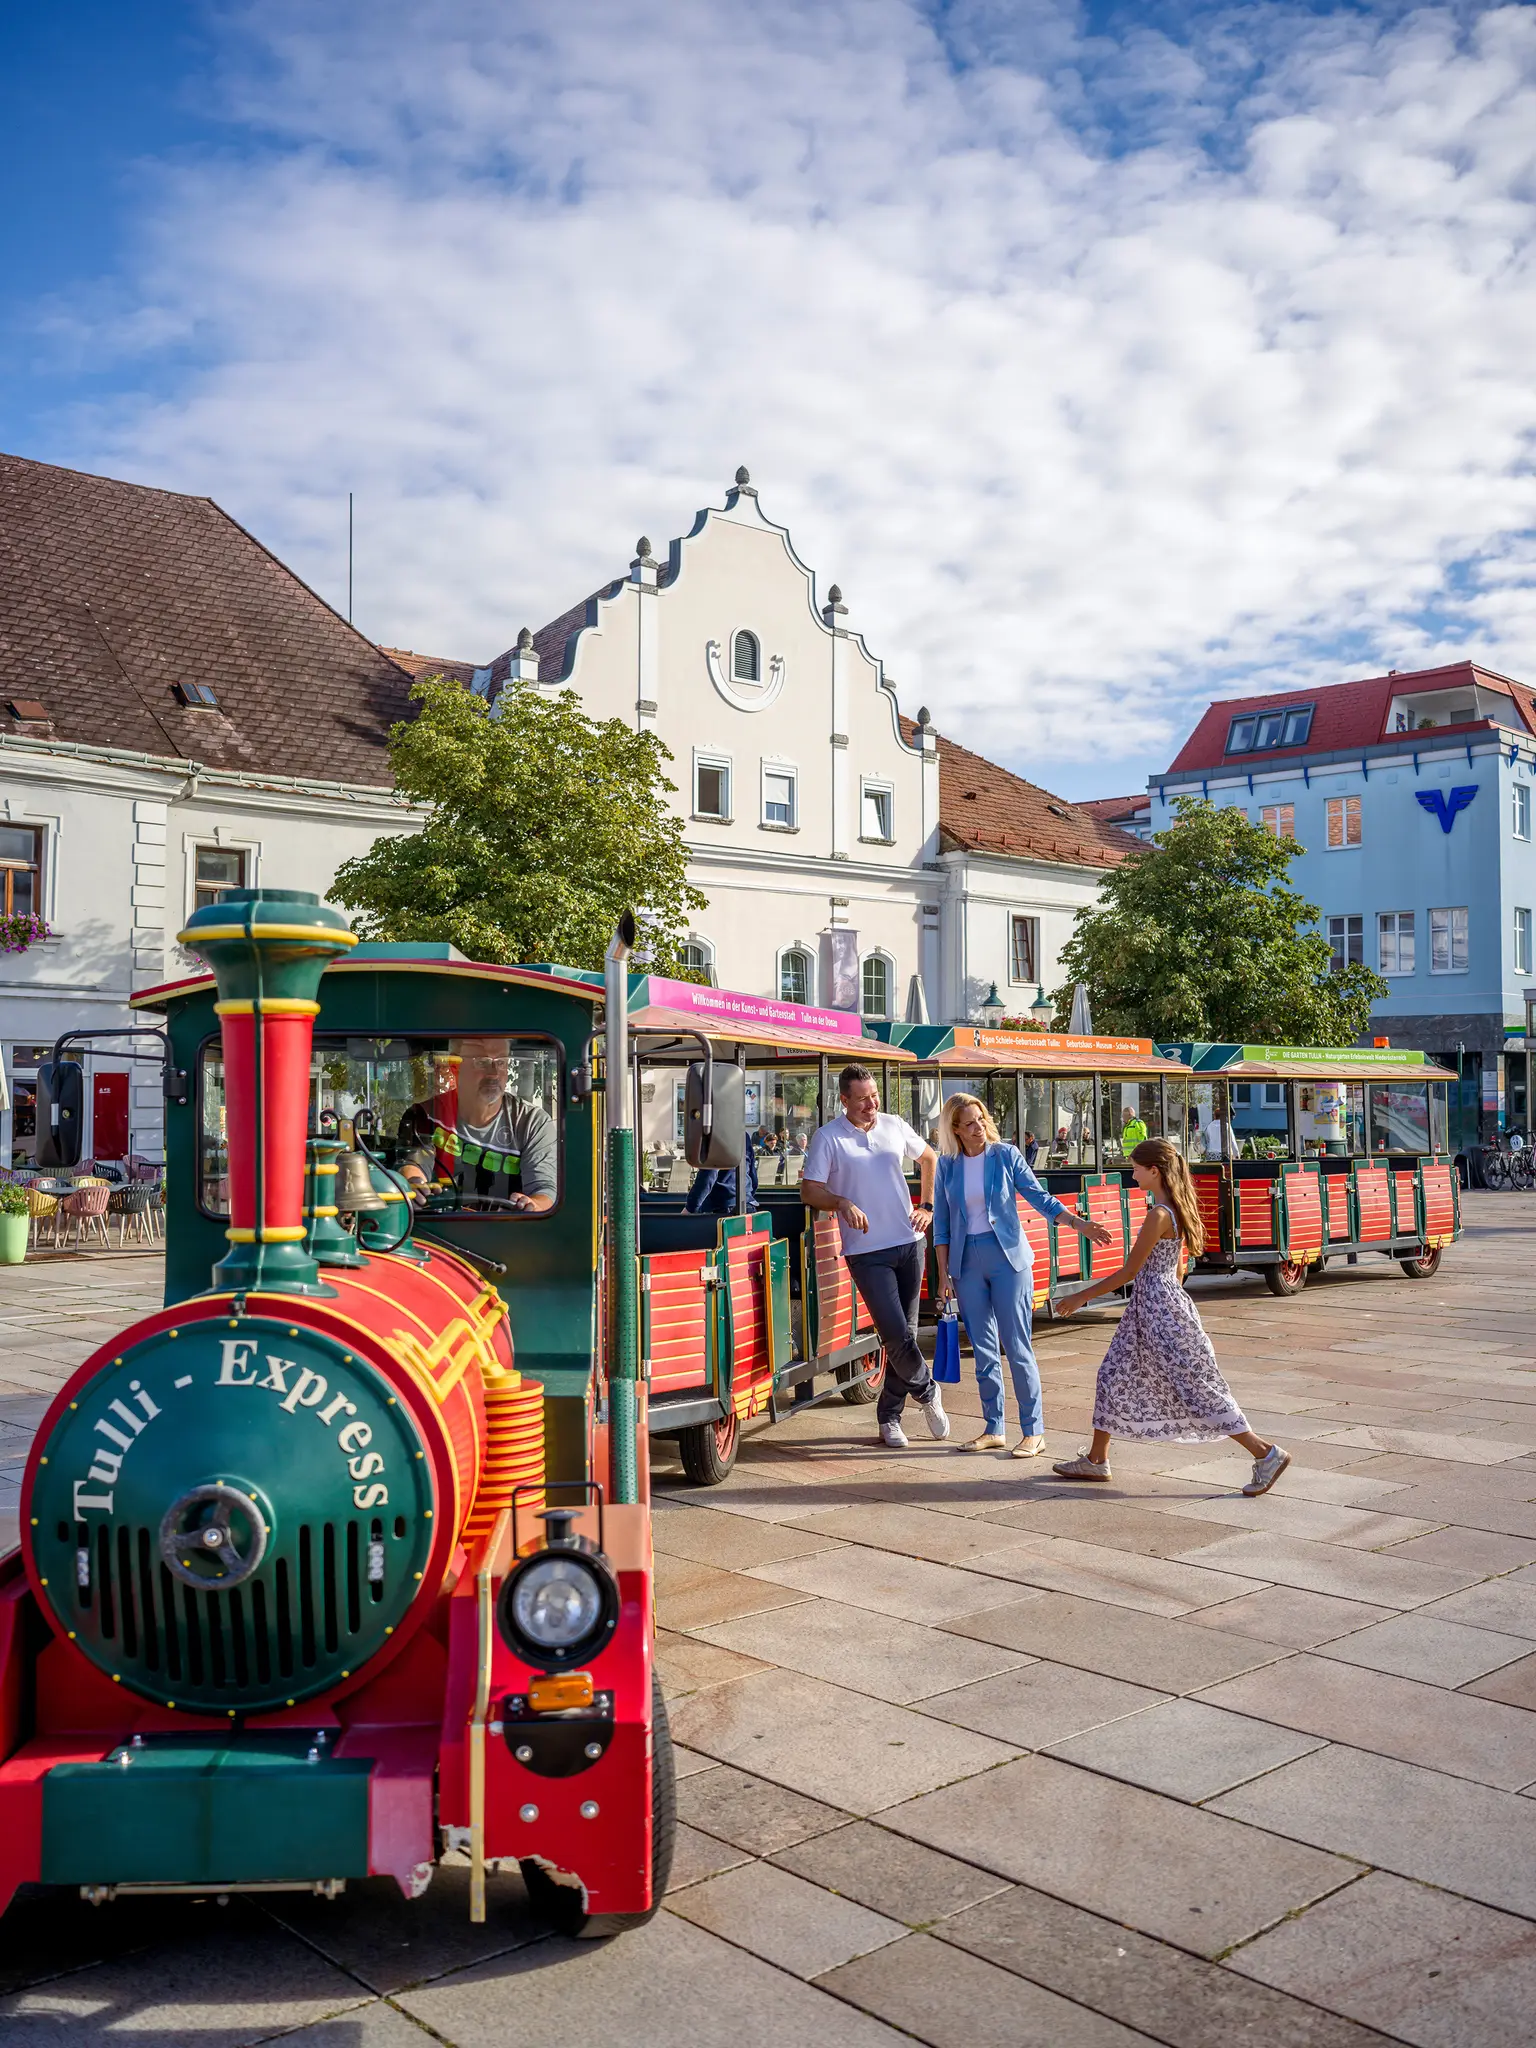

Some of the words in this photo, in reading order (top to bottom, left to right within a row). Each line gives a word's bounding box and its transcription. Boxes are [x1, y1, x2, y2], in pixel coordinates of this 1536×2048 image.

[691, 992, 725, 1009] Willkommen
[725, 998, 731, 1010] in
[732, 1000, 740, 1012] der
[759, 1006, 768, 1016] und
[768, 1006, 796, 1021] Gartenstadt
[800, 1011, 812, 1023] Tulln
[812, 1016, 818, 1024] an
[825, 1016, 838, 1027] Donau
[981, 1035, 995, 1045] Egon
[1066, 1039, 1093, 1048] Geburtshaus
[1095, 1041, 1112, 1049] Museum
[73, 1379, 162, 1522] Tulli
[214, 1339, 389, 1510] Express
